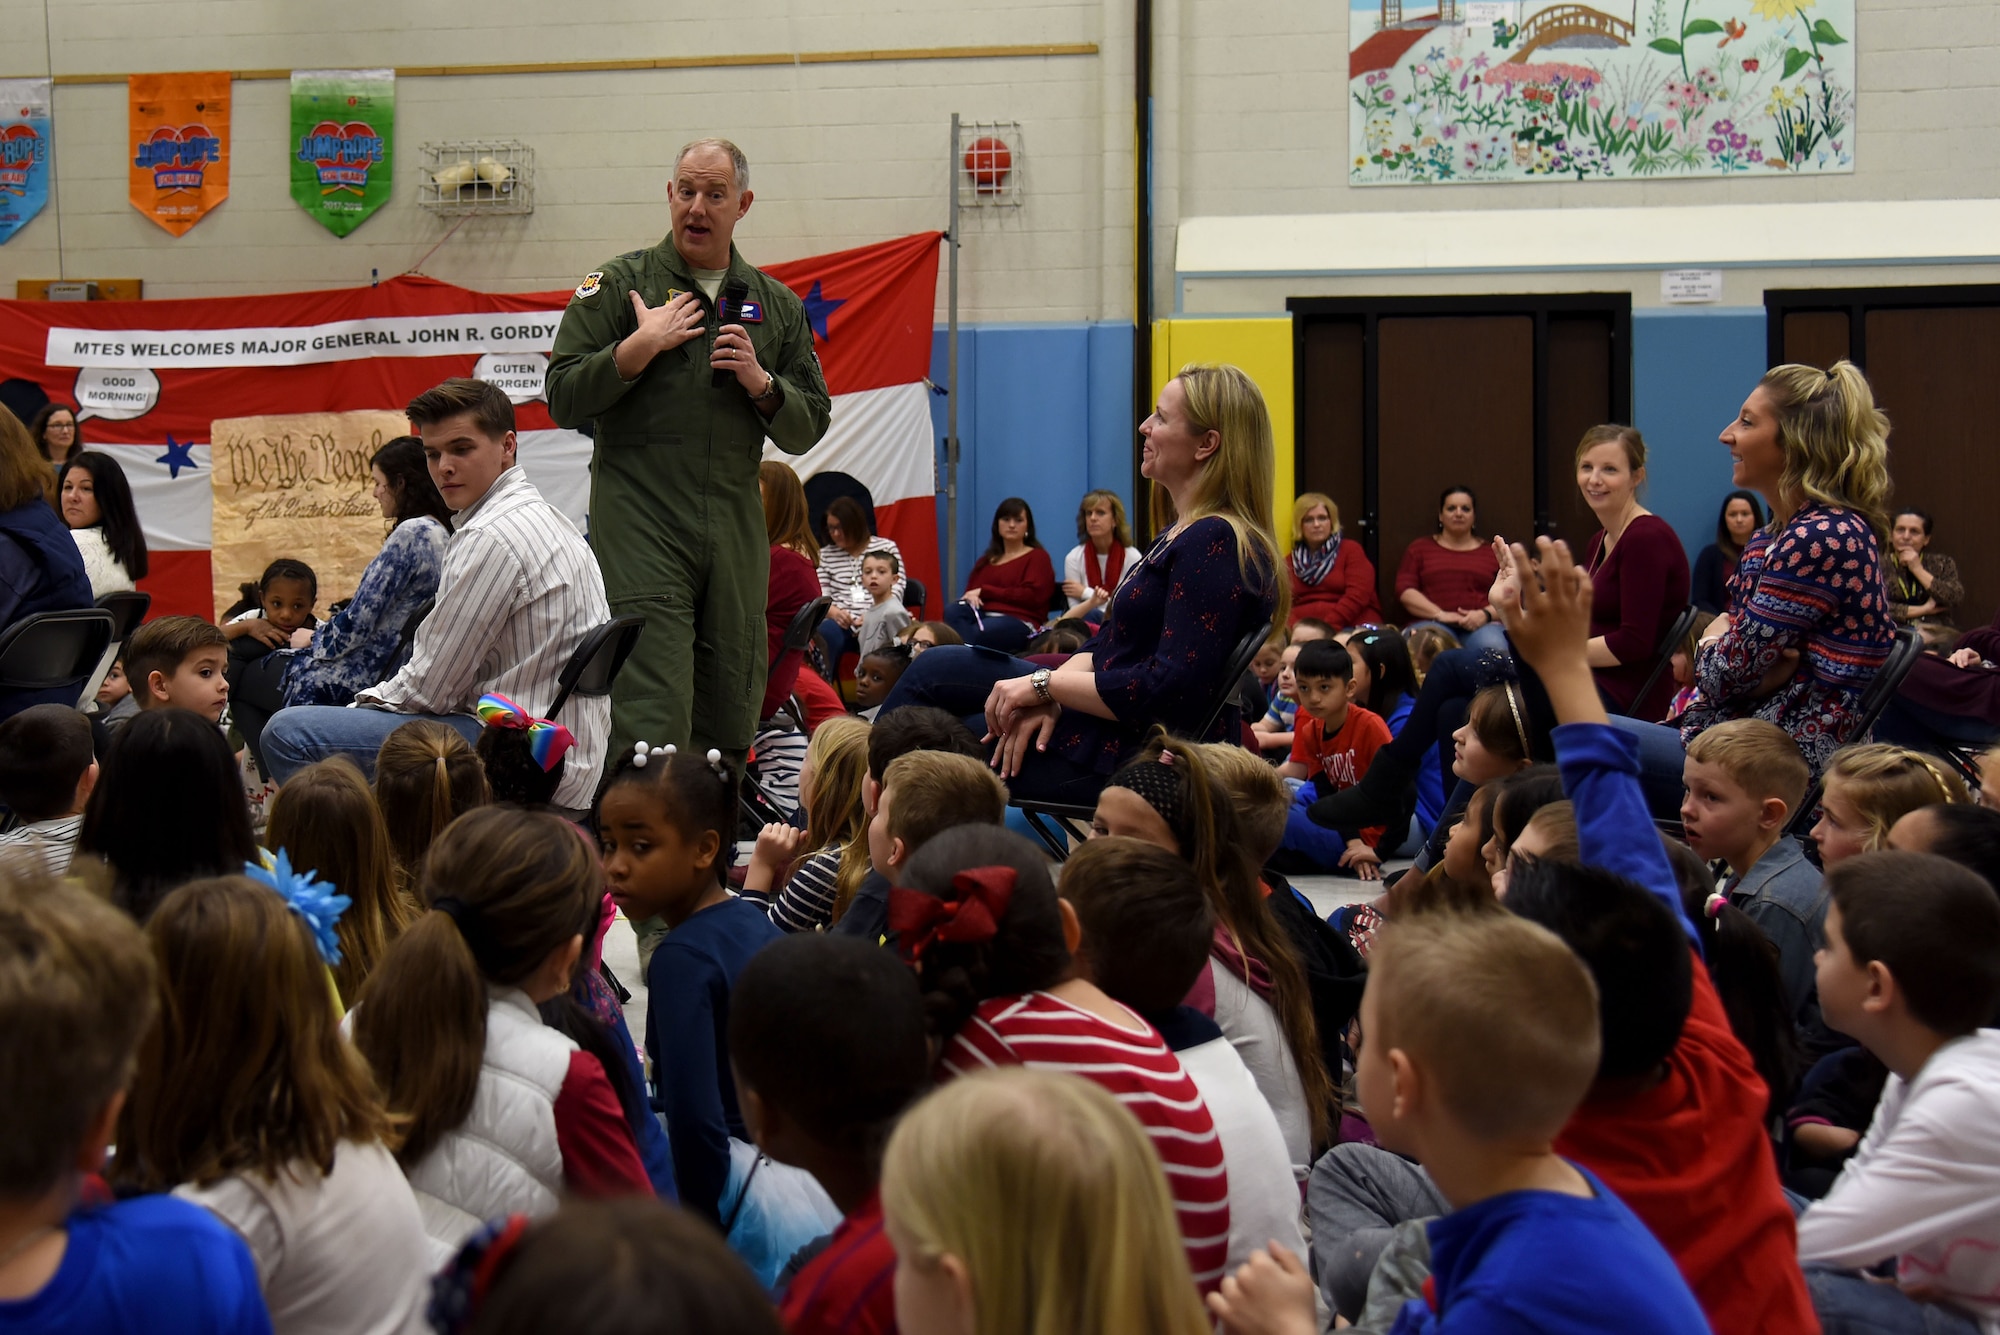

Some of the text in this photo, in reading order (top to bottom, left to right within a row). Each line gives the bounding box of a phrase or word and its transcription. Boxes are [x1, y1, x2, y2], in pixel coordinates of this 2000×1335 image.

[5, 138, 45, 164] ROPE
[135, 136, 220, 168] JUMP ROPE
[298, 134, 384, 163] JUMP ROPE
[322, 170, 365, 184] FOR HEART
[73, 325, 556, 356] MTES WELCOMES MAJOR GENERAL JOHN R. GORDY
[102, 377, 136, 387] GOOD
[493, 364, 536, 374] GUTEN
[88, 391, 147, 402] MORNING!
[226, 433, 273, 495] We
[305, 429, 384, 493] Peopl
[283, 496, 329, 518] United
[327, 491, 375, 518] States
